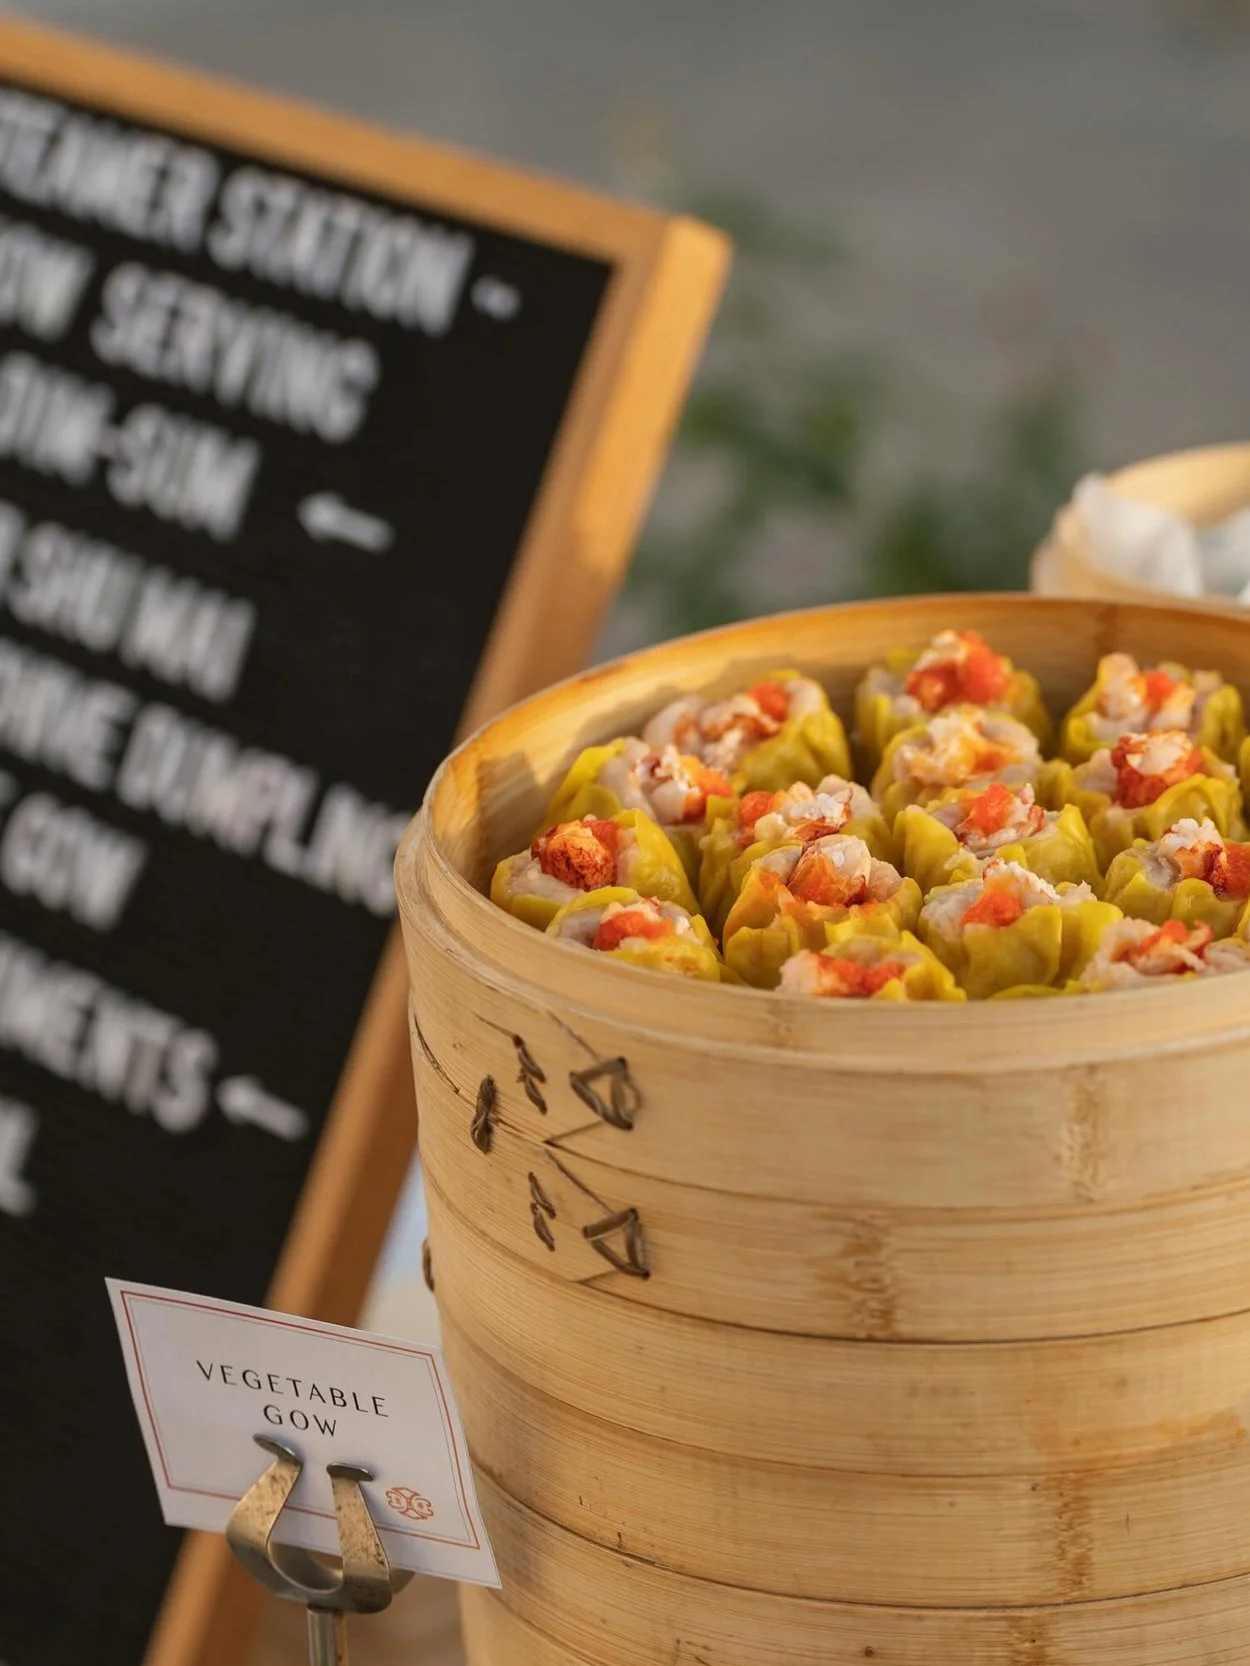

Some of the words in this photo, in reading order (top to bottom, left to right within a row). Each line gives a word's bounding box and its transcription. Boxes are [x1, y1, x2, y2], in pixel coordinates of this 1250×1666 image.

[207, 165, 475, 338] STATION
[90, 262, 380, 445] SERVING
[196, 1360, 389, 1418] VEGETABLE
[263, 1404, 336, 1437] GOW
